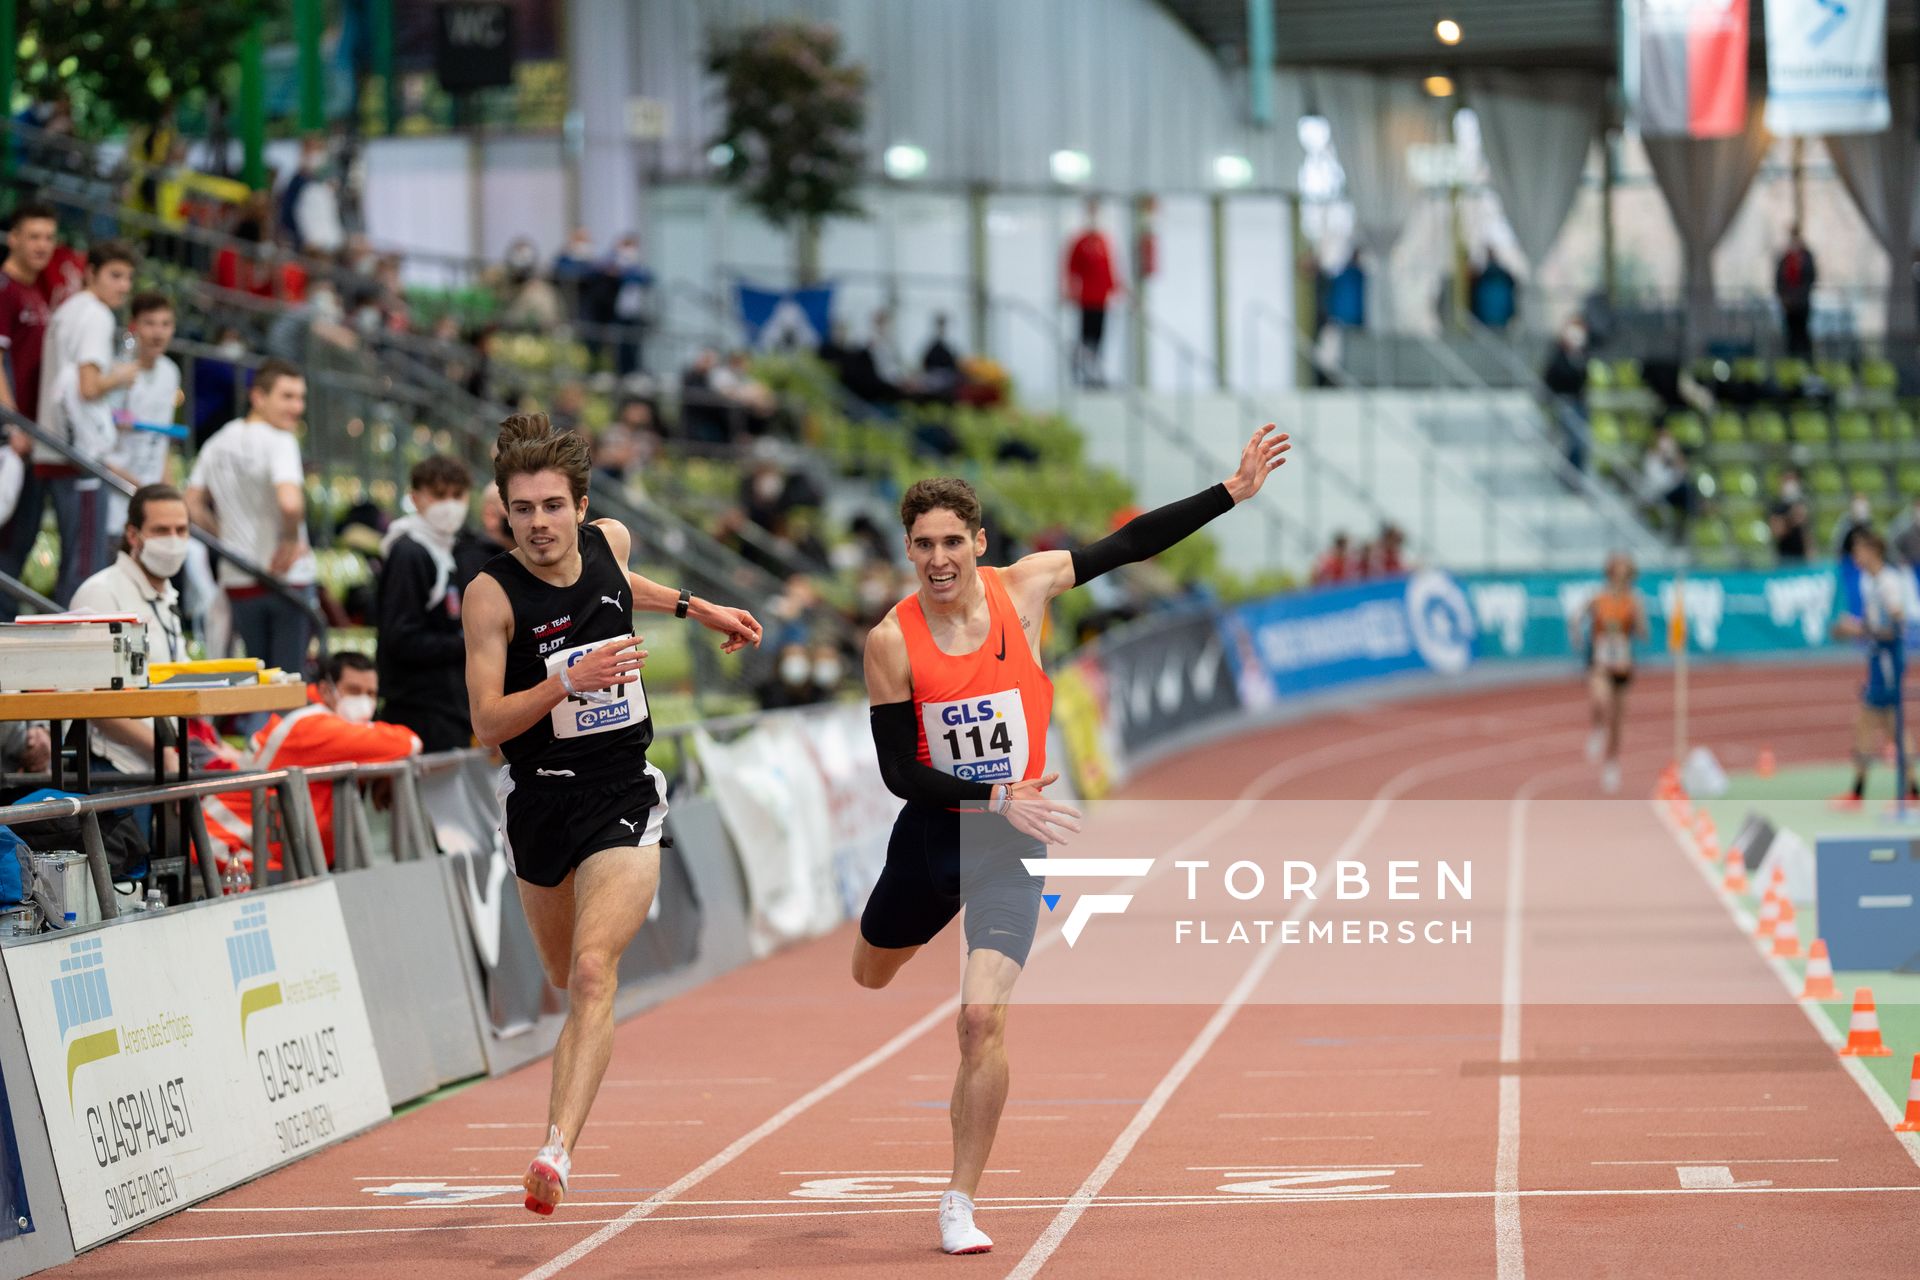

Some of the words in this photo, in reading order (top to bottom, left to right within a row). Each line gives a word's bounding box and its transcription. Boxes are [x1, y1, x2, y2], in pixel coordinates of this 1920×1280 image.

[532, 624, 547, 634] TOP
[551, 614, 571, 628] TEAM
[599, 705, 627, 719] PLAN
[943, 722, 1013, 760] 114
[977, 762, 1008, 774] PLAN
[121, 1024, 149, 1055] Arena
[146, 1018, 164, 1048] des
[160, 1011, 193, 1048] Erfolges
[258, 1027, 345, 1102] GLASPALAST
[86, 1077, 193, 1168] GLASPALAST
[105, 1165, 178, 1226] SINDELFINGEN
